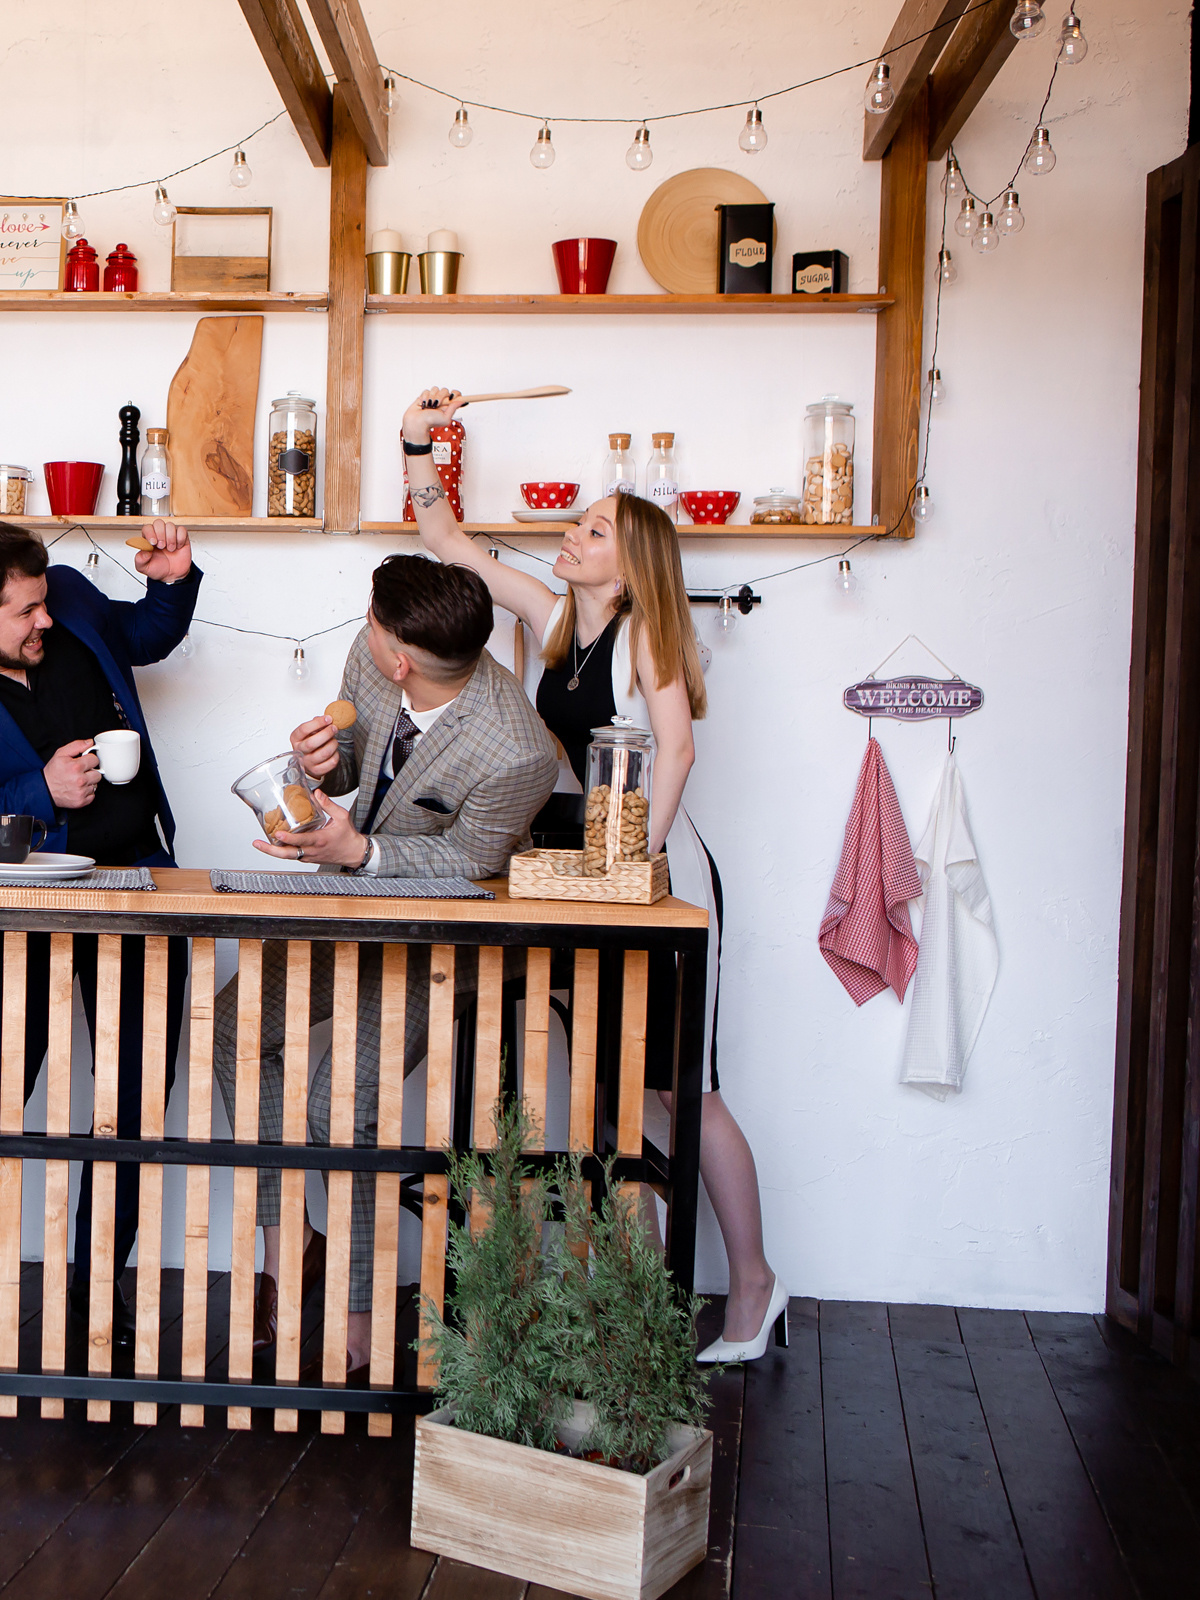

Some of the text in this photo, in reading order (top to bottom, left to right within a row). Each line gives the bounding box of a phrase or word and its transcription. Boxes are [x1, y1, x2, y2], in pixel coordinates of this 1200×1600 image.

[1, 218, 35, 233] love
[735, 247, 765, 257] FLOUR
[15, 268, 36, 288] up
[800, 272, 830, 285] SUGAR
[433, 445, 448, 453] КА
[856, 689, 972, 707] WELCOME
